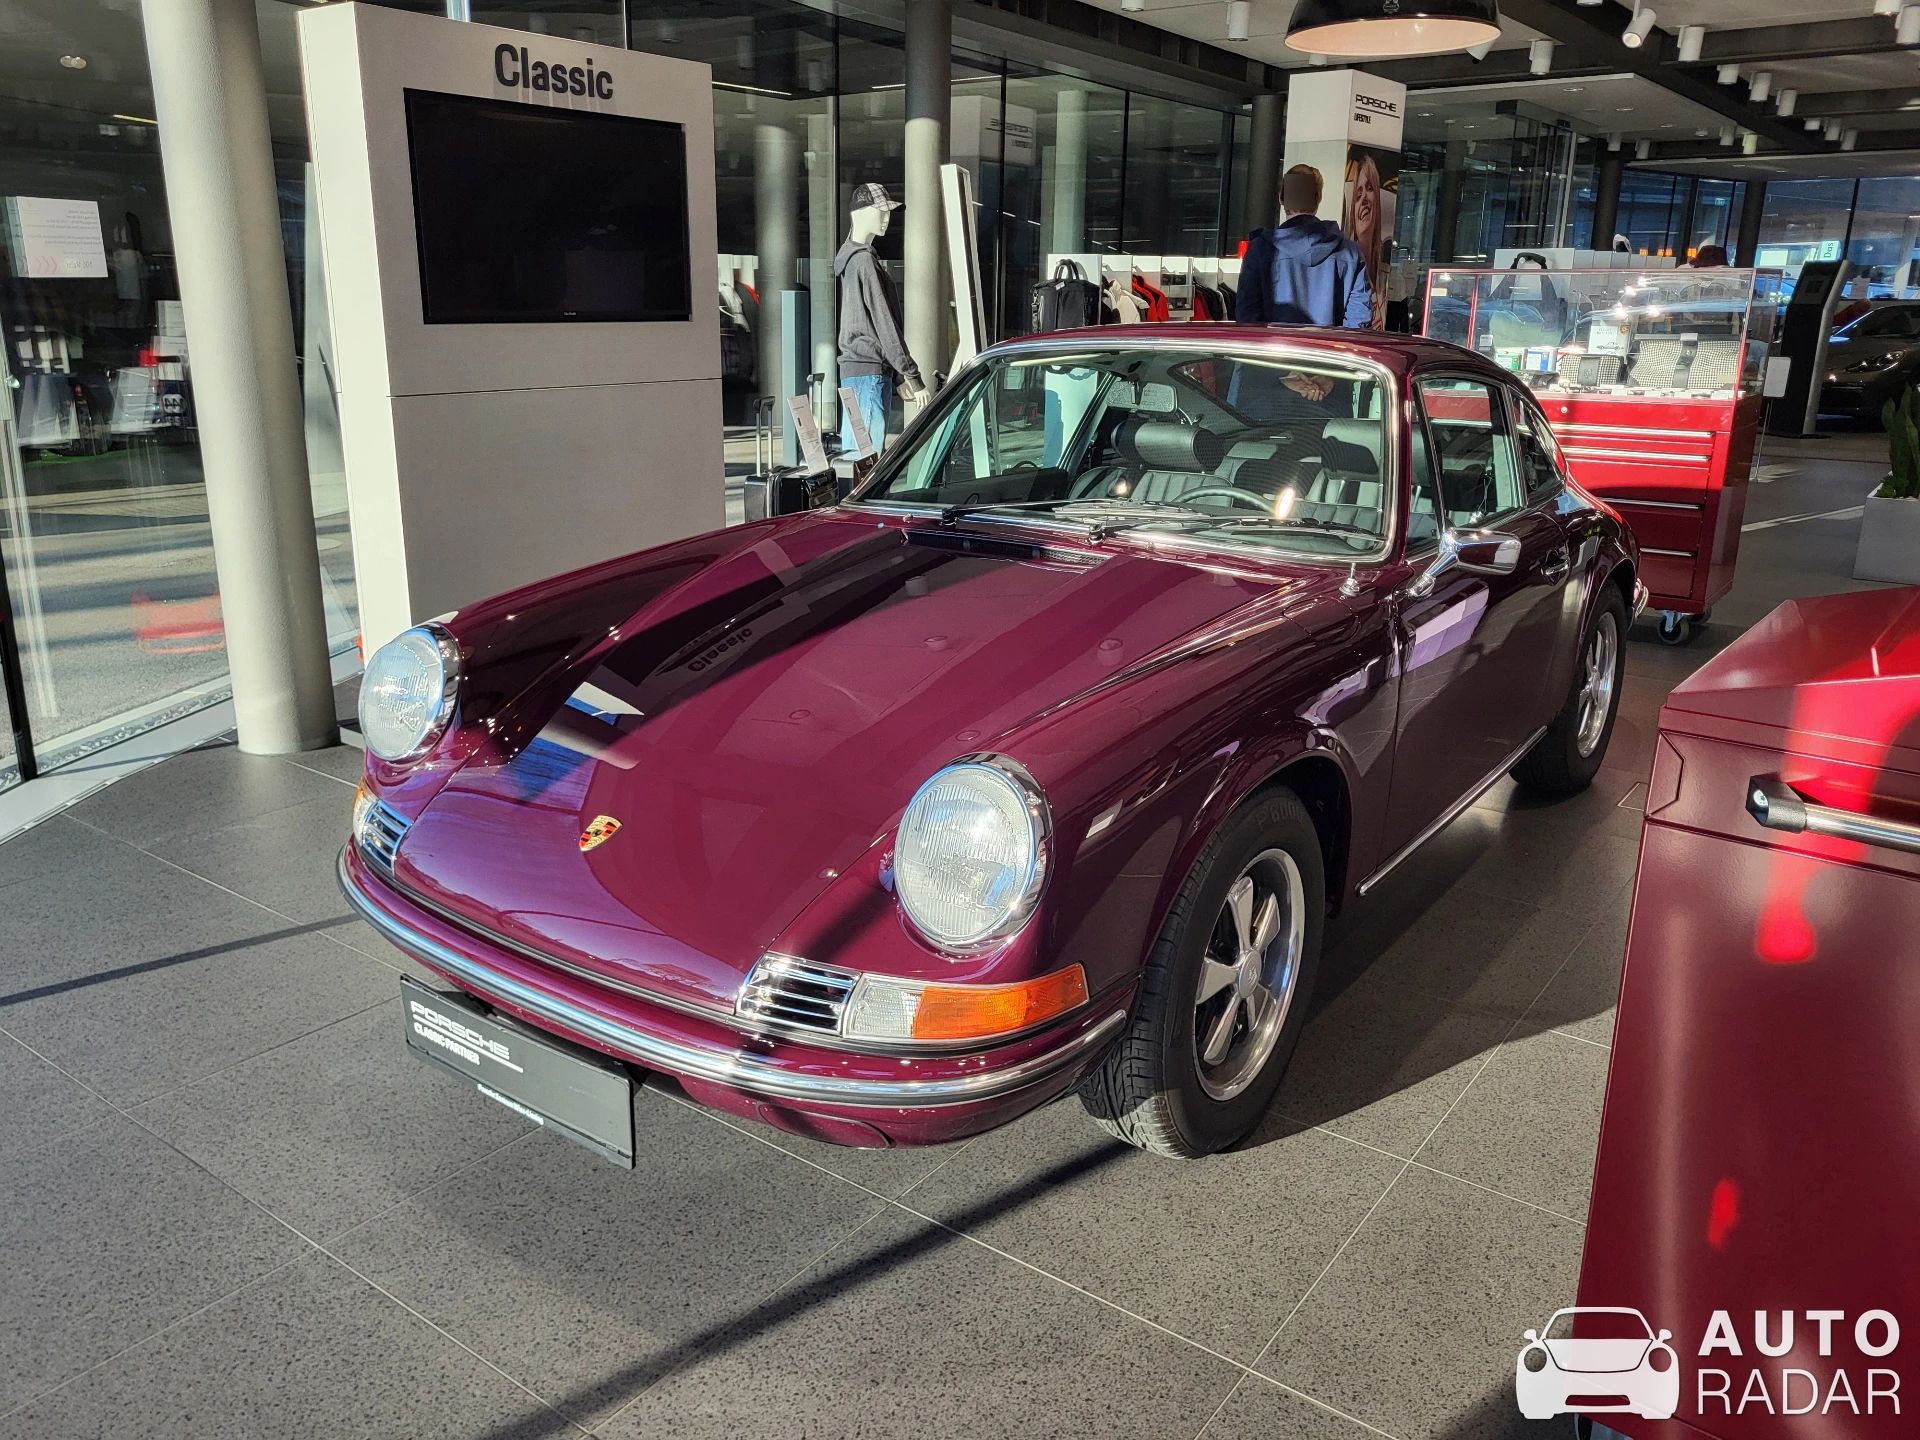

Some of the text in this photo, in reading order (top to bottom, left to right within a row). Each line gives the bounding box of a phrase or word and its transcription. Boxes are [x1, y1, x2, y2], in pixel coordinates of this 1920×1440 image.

[494, 43, 614, 100] Classic
[1355, 94, 1397, 113] PORSCHE
[410, 1000, 510, 1060] PORSCHE
[413, 1022, 481, 1066] CLASSIC PARTNER
